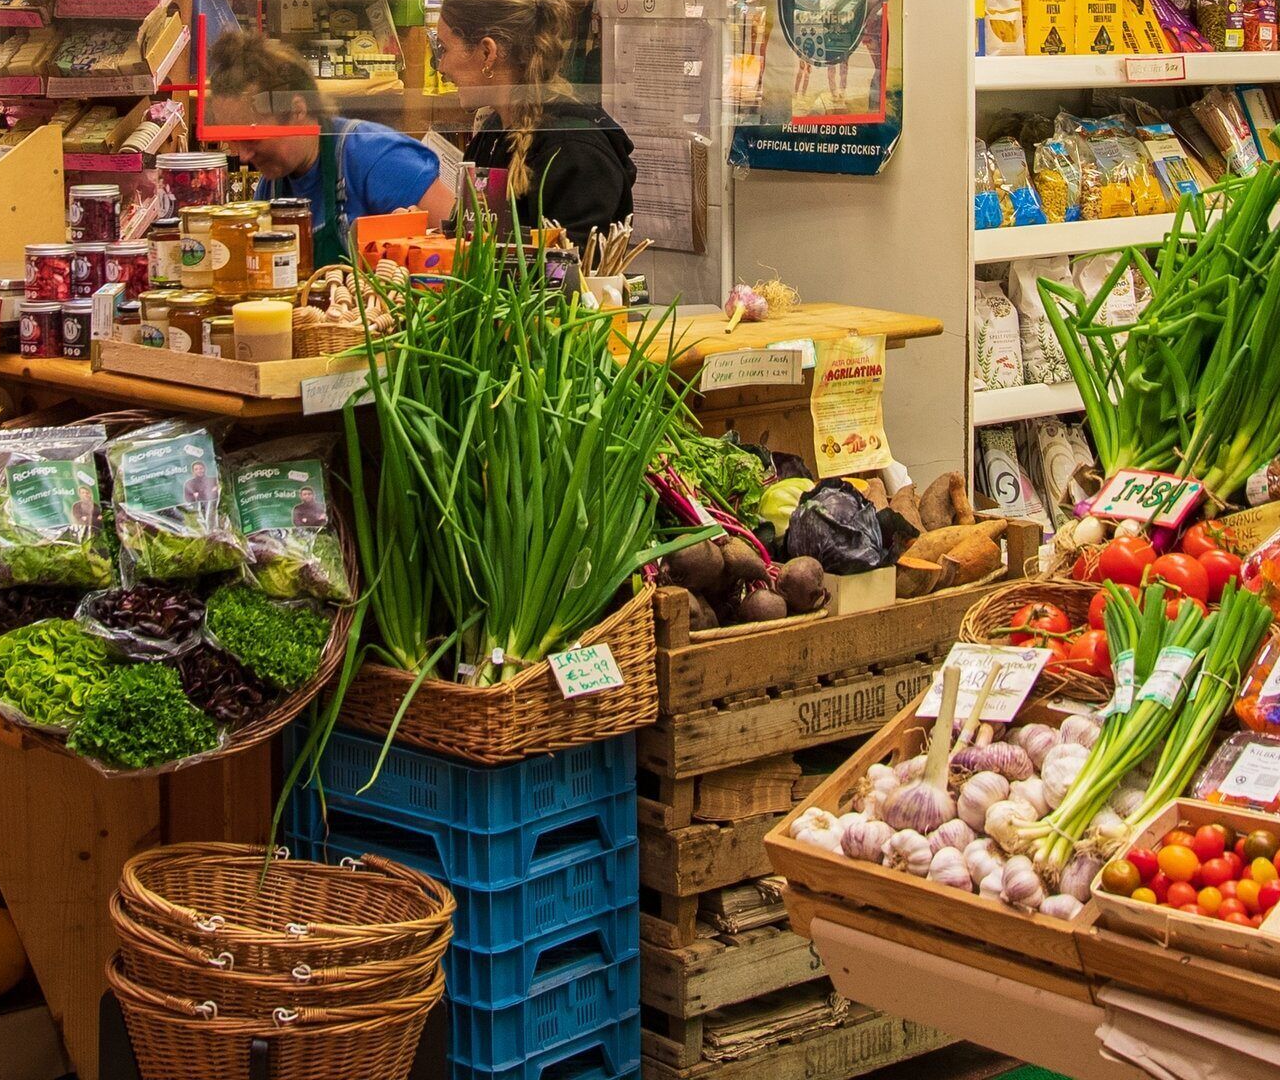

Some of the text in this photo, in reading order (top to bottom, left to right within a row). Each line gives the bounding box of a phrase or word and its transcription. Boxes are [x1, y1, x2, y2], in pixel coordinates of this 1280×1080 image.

[781, 122, 858, 137] PREMIUM CBD OILS
[756, 139, 881, 157] OFFICIAL LOVE HEMP STOCKIST
[826, 363, 883, 382] AGRILATINA
[127, 446, 173, 464] RICHARD'S
[12, 464, 58, 483] RICHARD'S
[129, 464, 188, 484] Summer Salad
[237, 467, 281, 485] RICHARD'S
[17, 486, 76, 505] Summer Salad
[239, 488, 297, 506] Summer Salad
[553, 647, 598, 670] IRISH
[568, 684, 576, 694] A
[798, 682, 887, 735] BROTHERS
